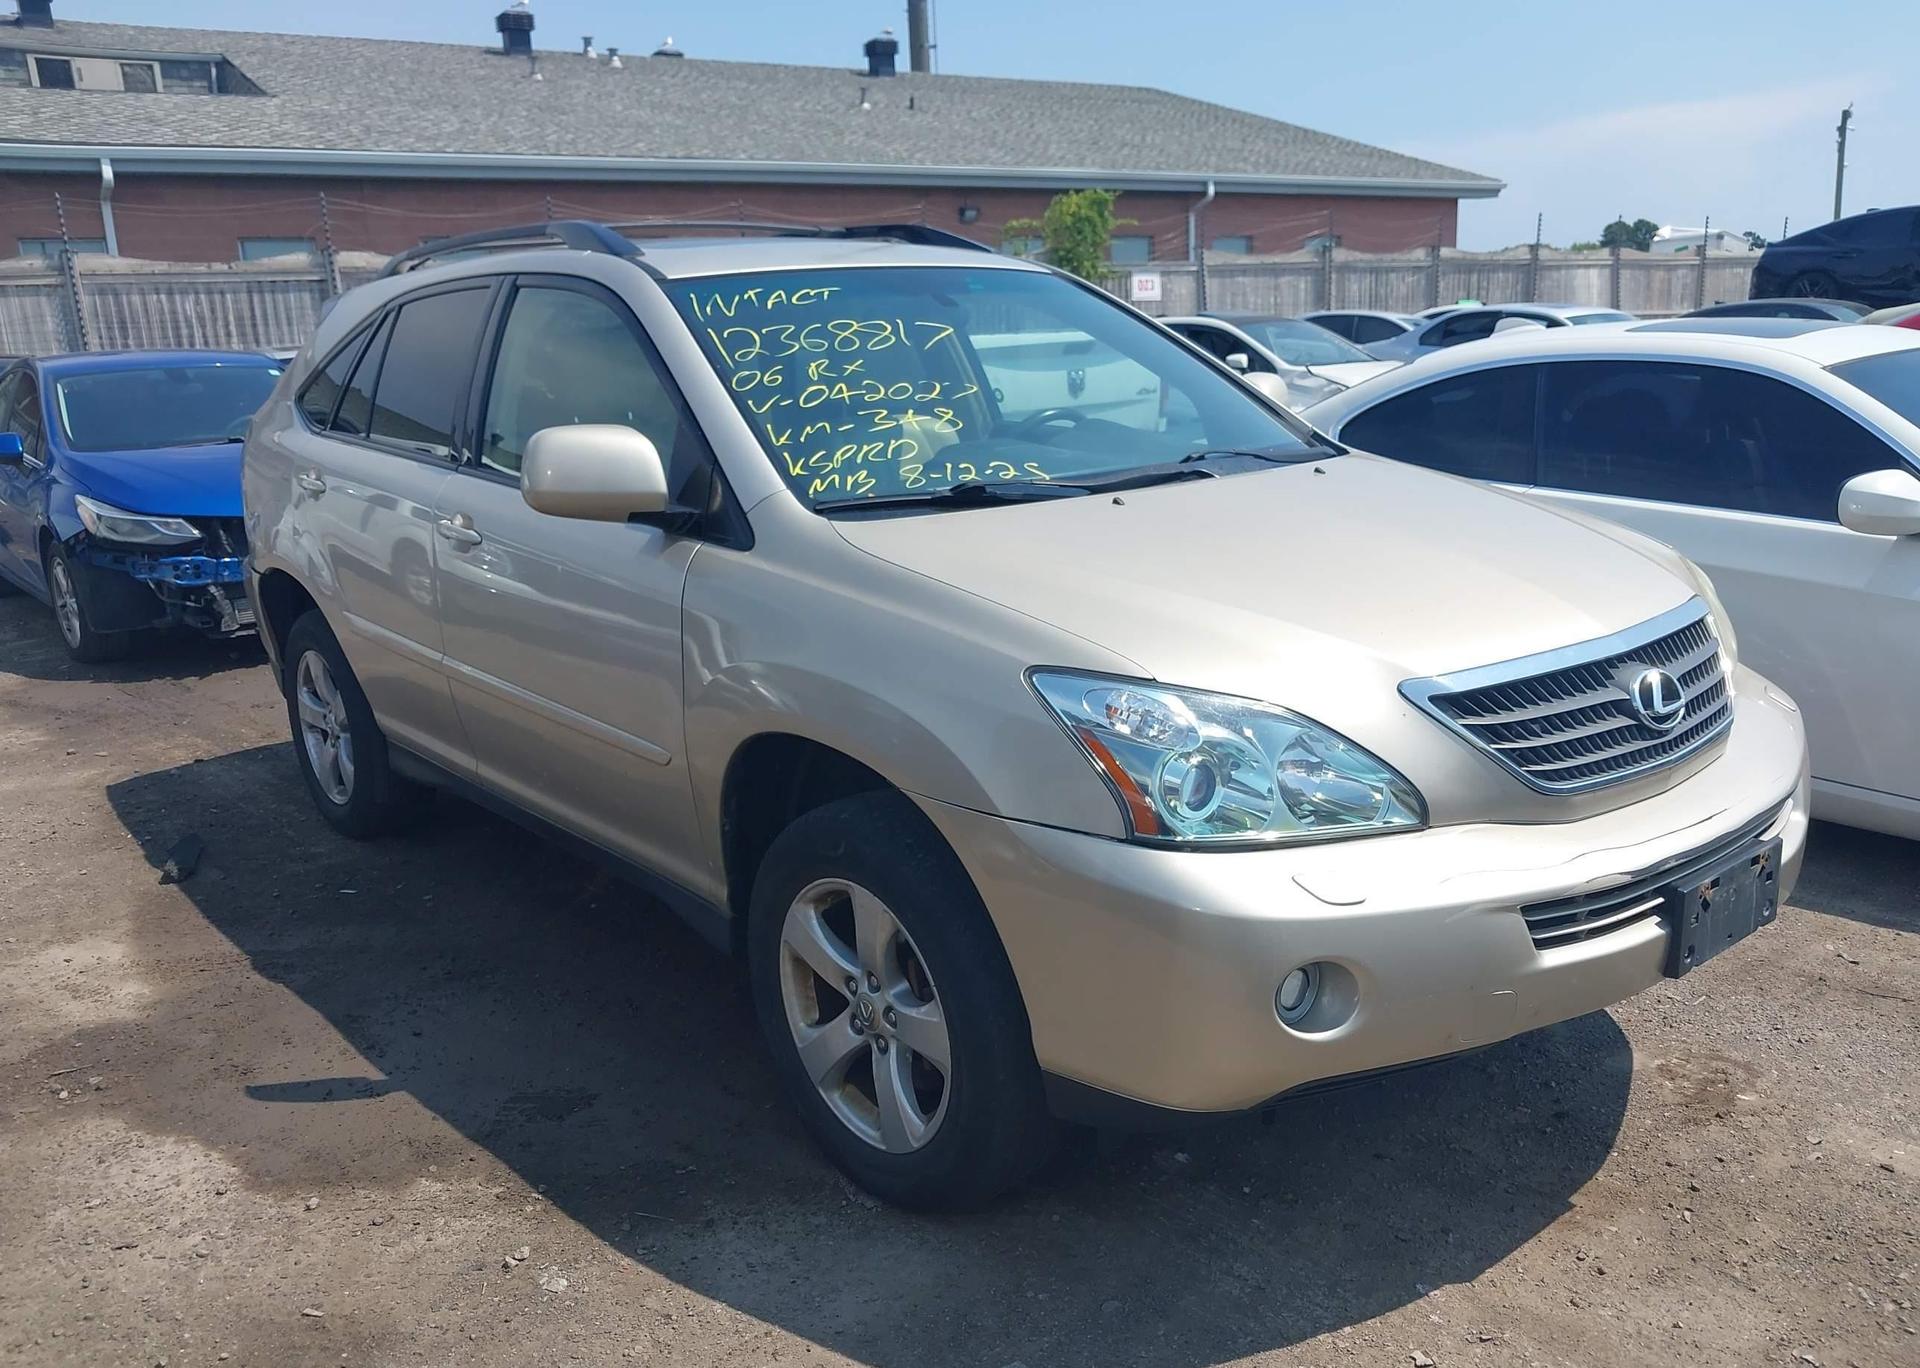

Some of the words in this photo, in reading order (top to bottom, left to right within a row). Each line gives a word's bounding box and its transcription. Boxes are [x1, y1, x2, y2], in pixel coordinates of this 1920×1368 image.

[690, 287, 842, 322] INTACT
[707, 319, 954, 369] 12368817
[732, 365, 783, 391] 06
